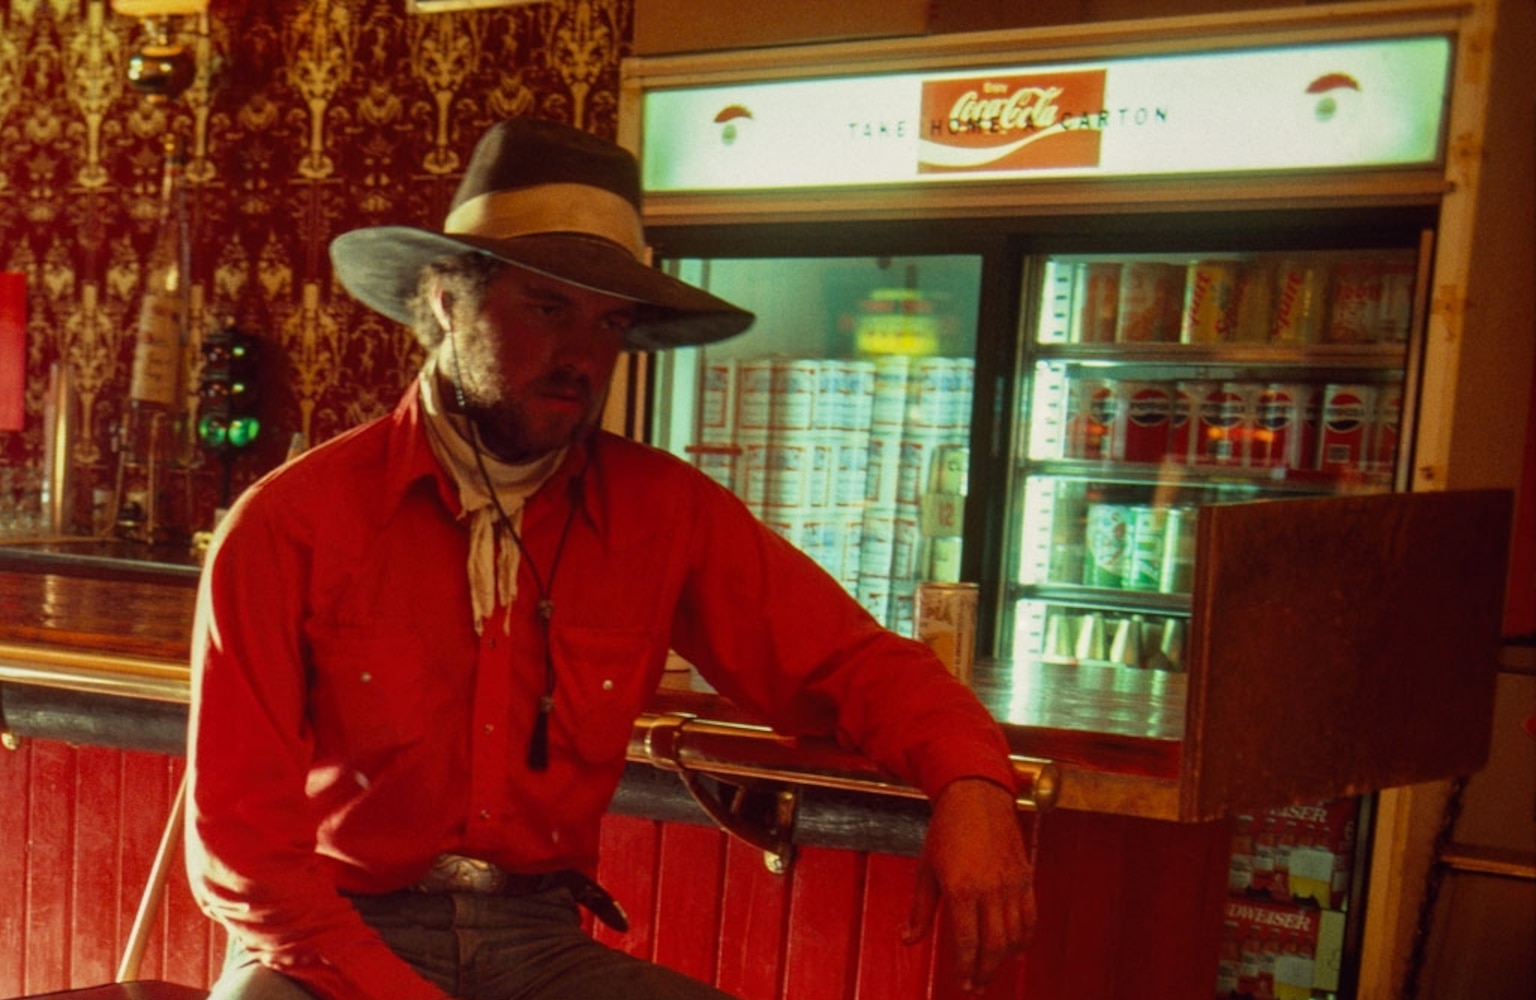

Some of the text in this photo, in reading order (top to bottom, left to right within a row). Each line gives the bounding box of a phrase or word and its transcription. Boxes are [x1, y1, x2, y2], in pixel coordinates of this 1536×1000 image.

[848, 120, 905, 138] TAKE
[1061, 107, 1168, 131] CARTON
[948, 85, 1065, 135] Coca-Cola
